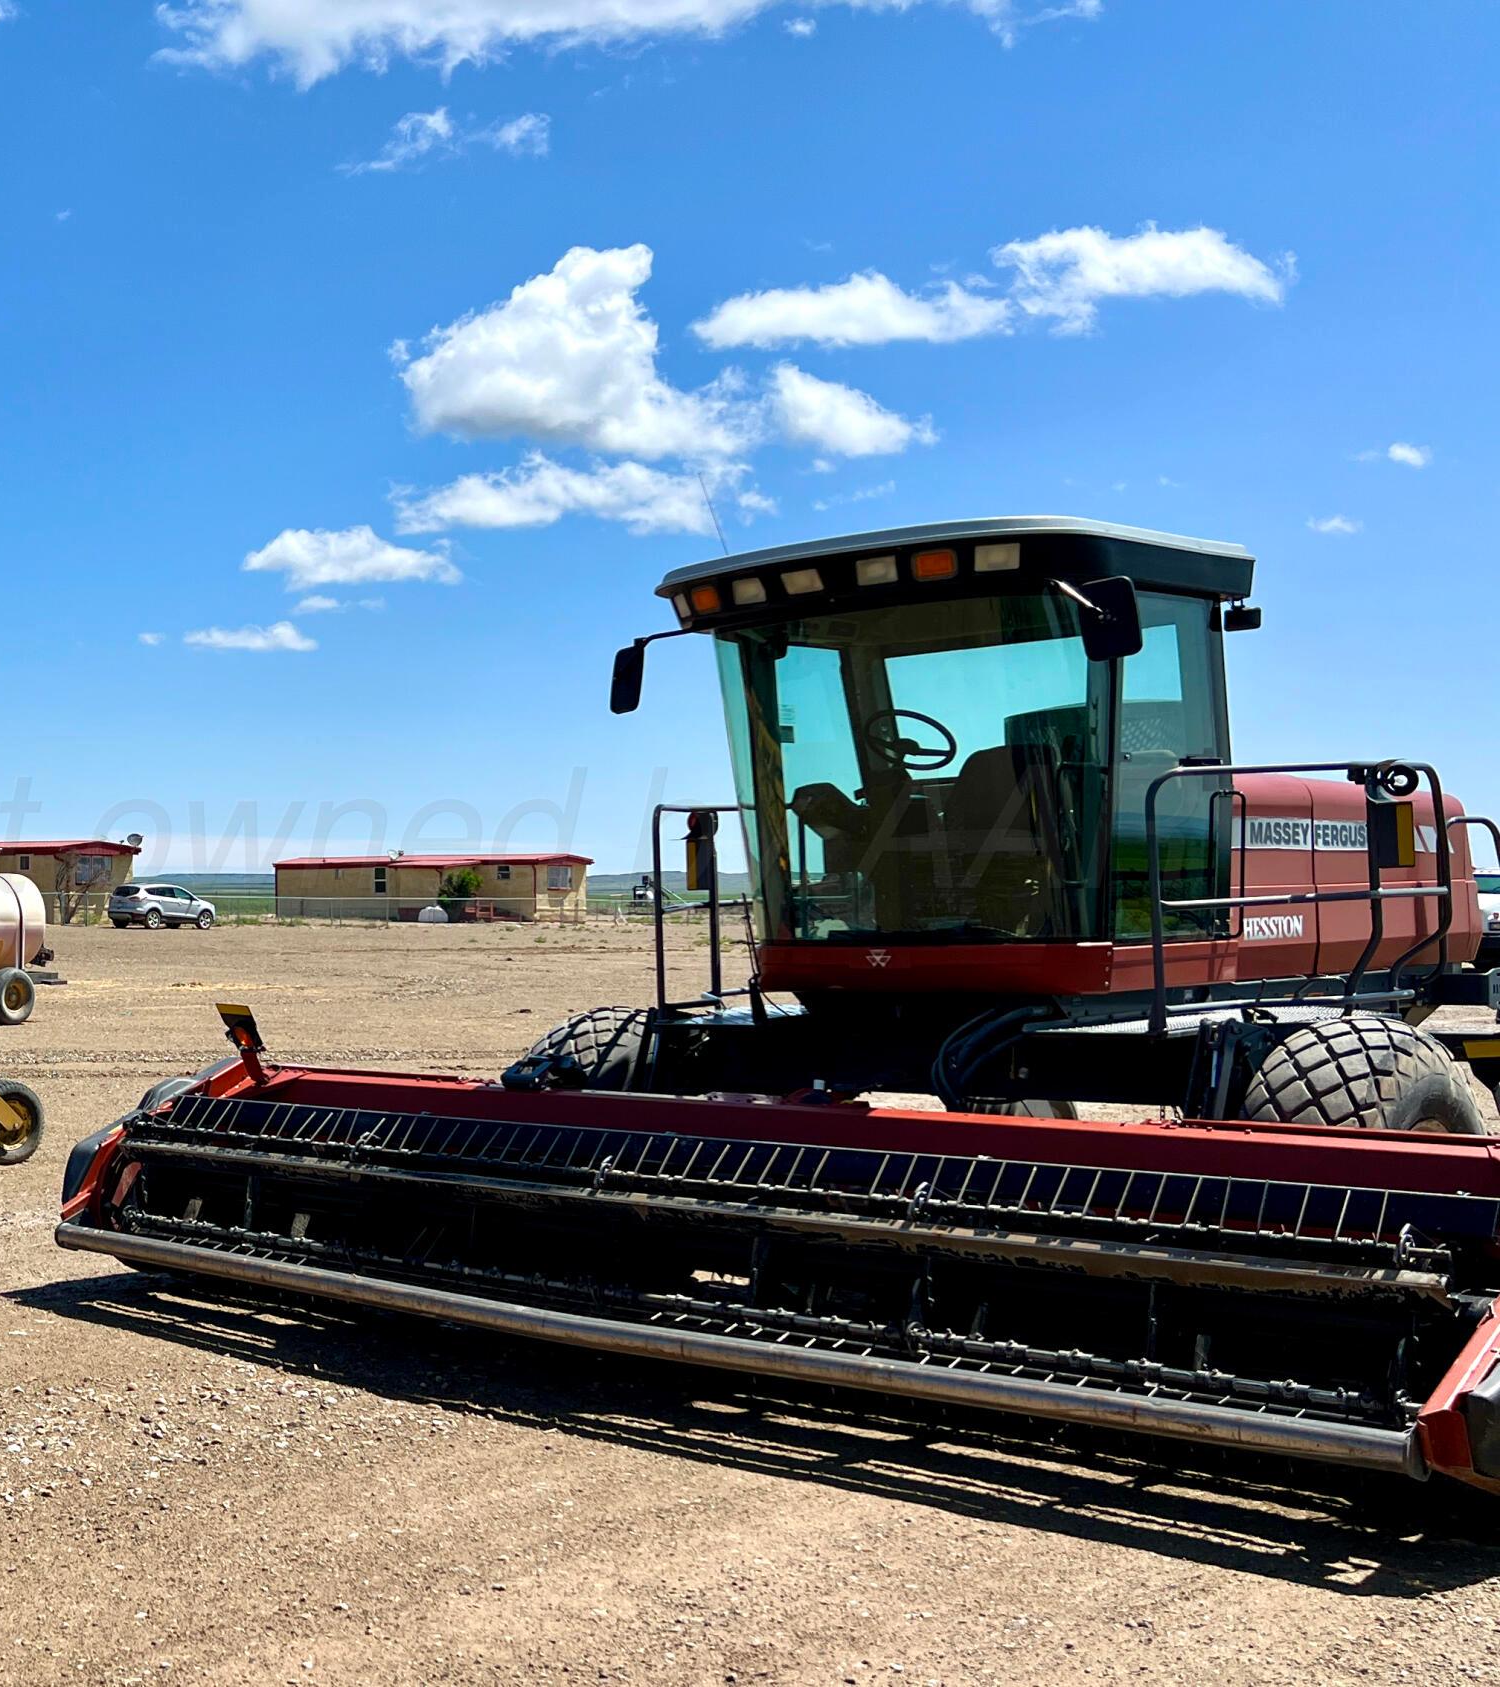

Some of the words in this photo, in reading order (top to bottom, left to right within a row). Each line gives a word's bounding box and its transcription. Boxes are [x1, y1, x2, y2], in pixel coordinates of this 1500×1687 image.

[1250, 821, 1310, 846] MASSEY
[1314, 824, 1368, 847] FERGUS
[1243, 915, 1303, 940] HESSTON
